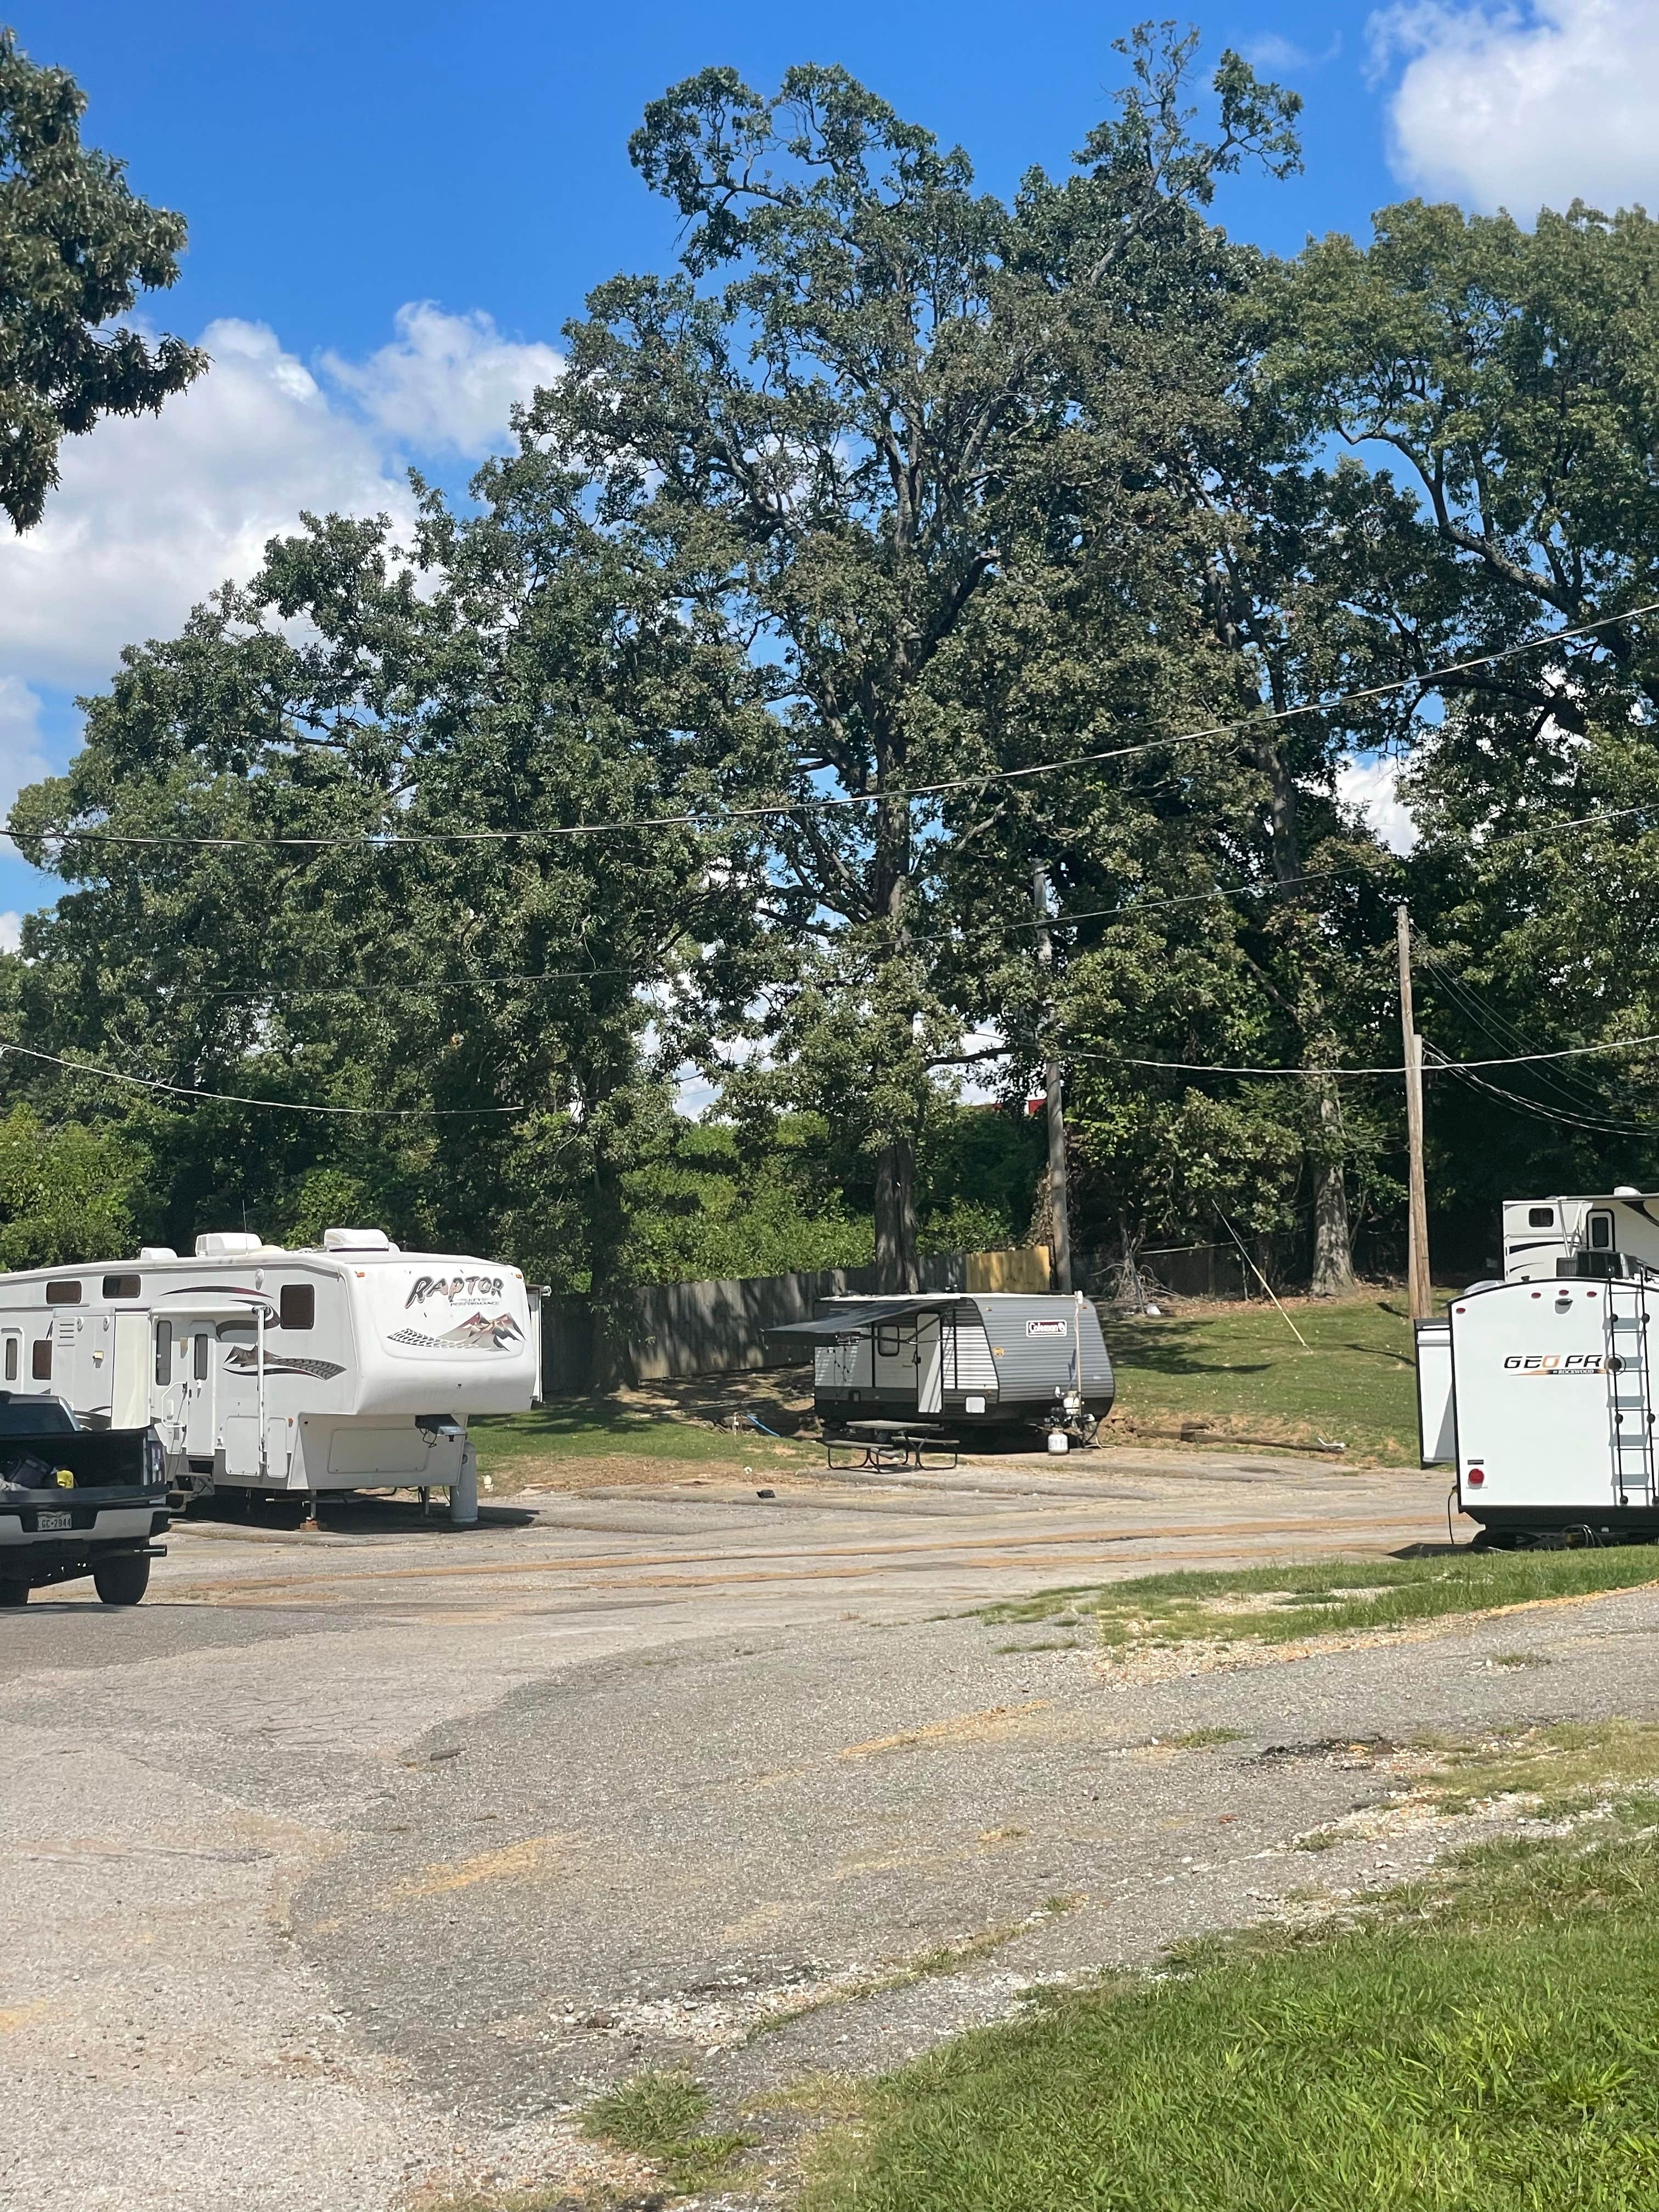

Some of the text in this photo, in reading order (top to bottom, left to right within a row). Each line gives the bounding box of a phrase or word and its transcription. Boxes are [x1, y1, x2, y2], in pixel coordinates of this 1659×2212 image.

[404, 1276, 504, 1309] RAPTOR
[1029, 1322, 1059, 1333] Coleman
[1504, 1355, 1561, 1368] GEO
